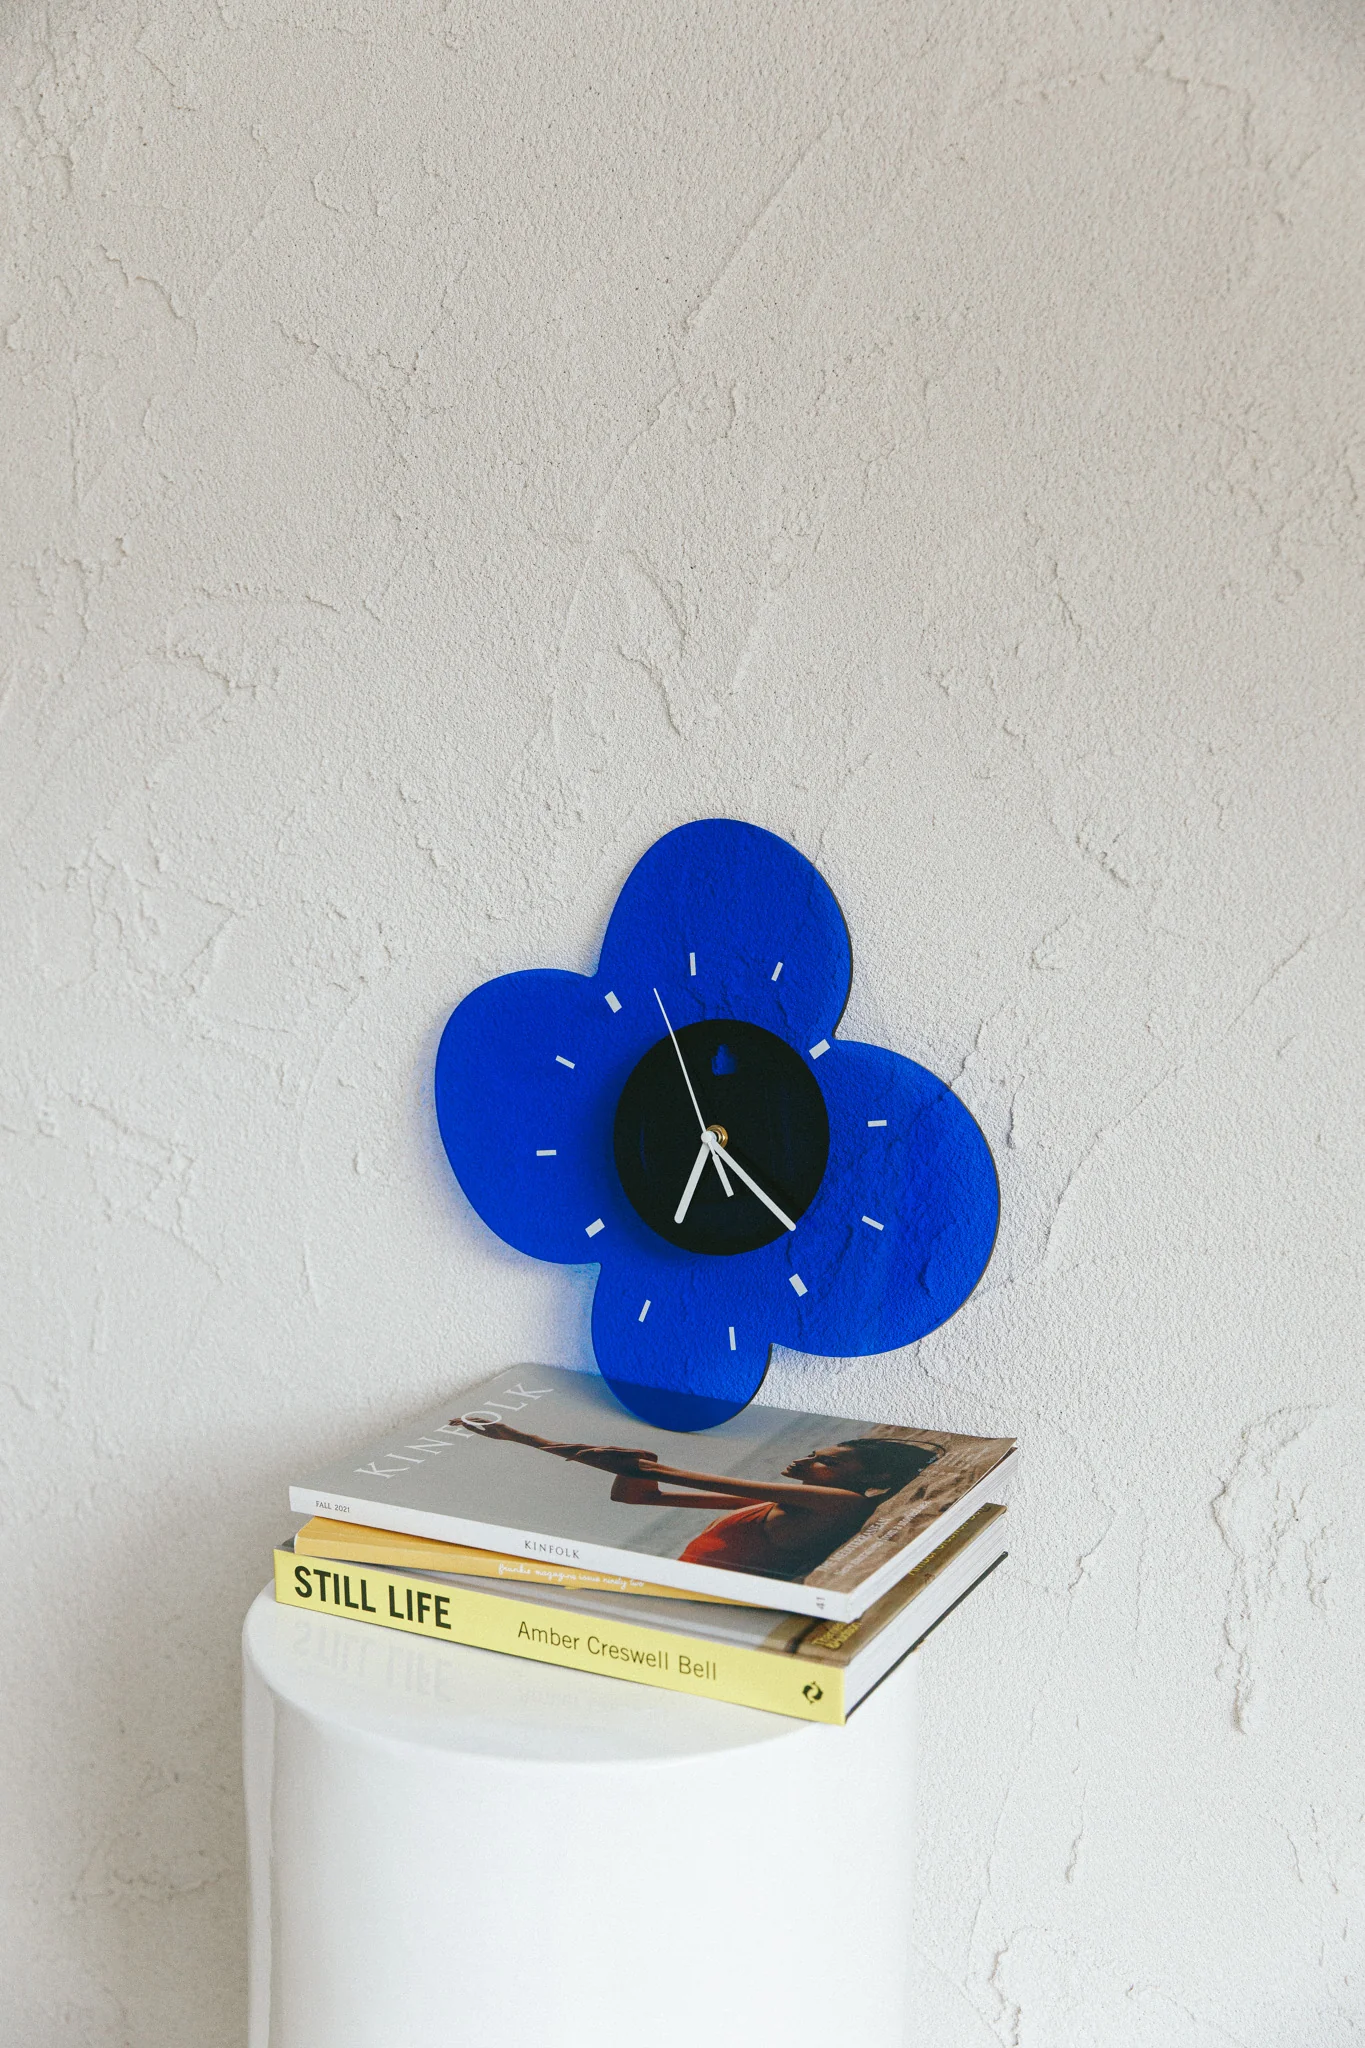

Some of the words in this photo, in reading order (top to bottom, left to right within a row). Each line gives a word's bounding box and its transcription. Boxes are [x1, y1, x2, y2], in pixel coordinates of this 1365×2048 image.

[353, 1383, 554, 1479] KINFOLK
[315, 1500, 332, 1510] FALL
[334, 1505, 350, 1513] 2021
[524, 1540, 580, 1559] KINFOLK
[294, 1565, 376, 1614] STILL
[388, 1585, 452, 1630] LIFE
[498, 1562, 531, 1576] frankie
[535, 1569, 577, 1583] magazine
[578, 1574, 600, 1582] issue
[602, 1577, 628, 1590] ninety
[630, 1577, 645, 1588] two
[518, 1620, 580, 1651] Amber
[586, 1635, 669, 1670] Creswell
[678, 1655, 718, 1681] Bell
